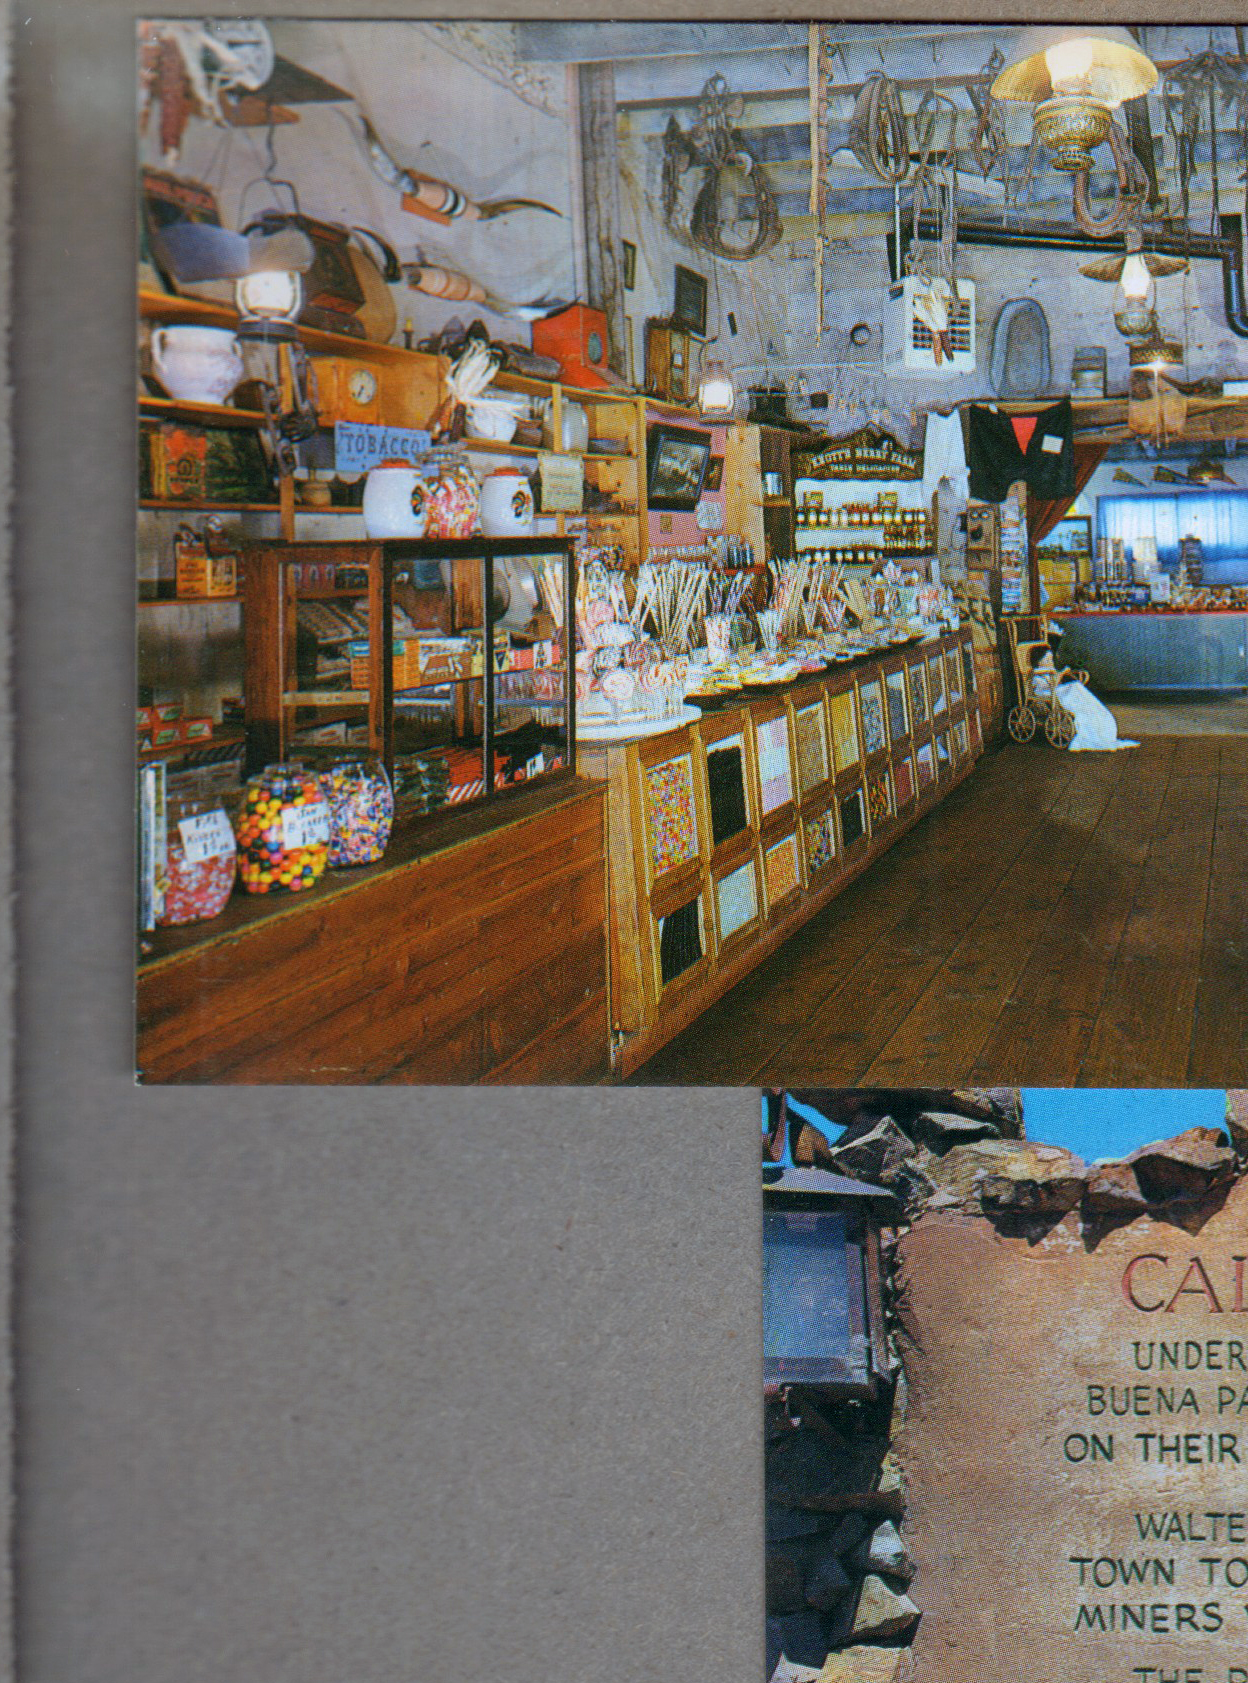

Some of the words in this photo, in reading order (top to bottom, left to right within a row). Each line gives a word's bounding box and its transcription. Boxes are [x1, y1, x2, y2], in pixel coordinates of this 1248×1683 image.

[1132, 1340, 1248, 1371] UNDER
[1088, 1386, 1199, 1417] BUENA
[1063, 1432, 1114, 1462] ON
[1135, 1432, 1240, 1464] THEIR
[1070, 1557, 1175, 1587] TOWN
[1074, 1603, 1223, 1632] MINERS
